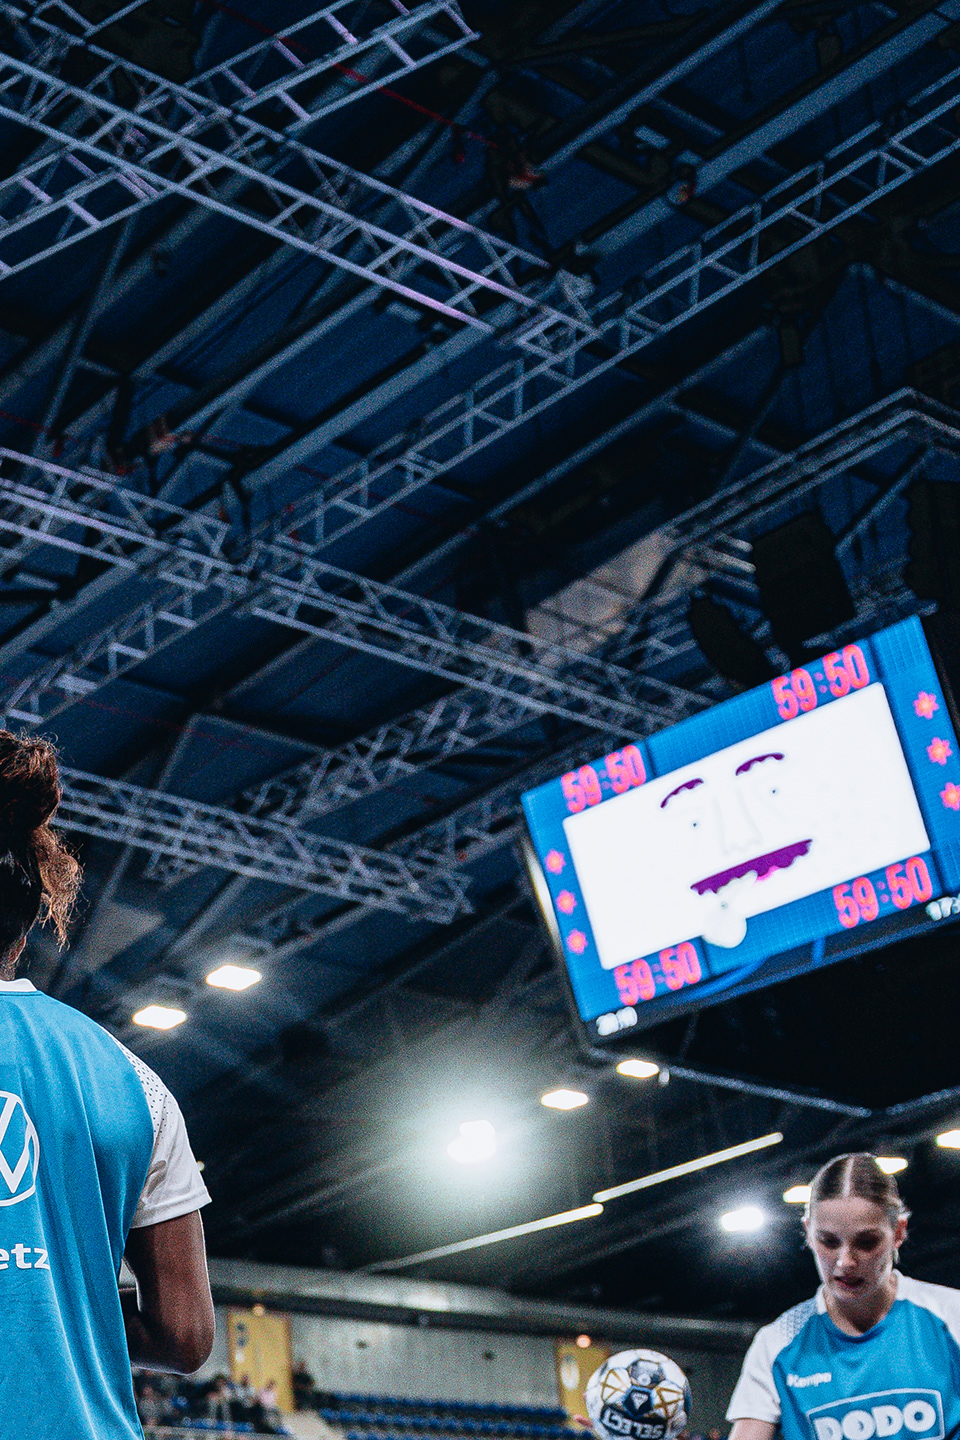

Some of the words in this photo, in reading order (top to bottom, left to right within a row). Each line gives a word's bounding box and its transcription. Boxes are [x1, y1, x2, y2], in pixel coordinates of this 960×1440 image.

[771, 644, 870, 720] 59:50
[561, 744, 646, 813] 59:50
[832, 856, 933, 928] 59:50
[613, 941, 702, 1006] 59:50
[601, 1407, 666, 1439] SELECT
